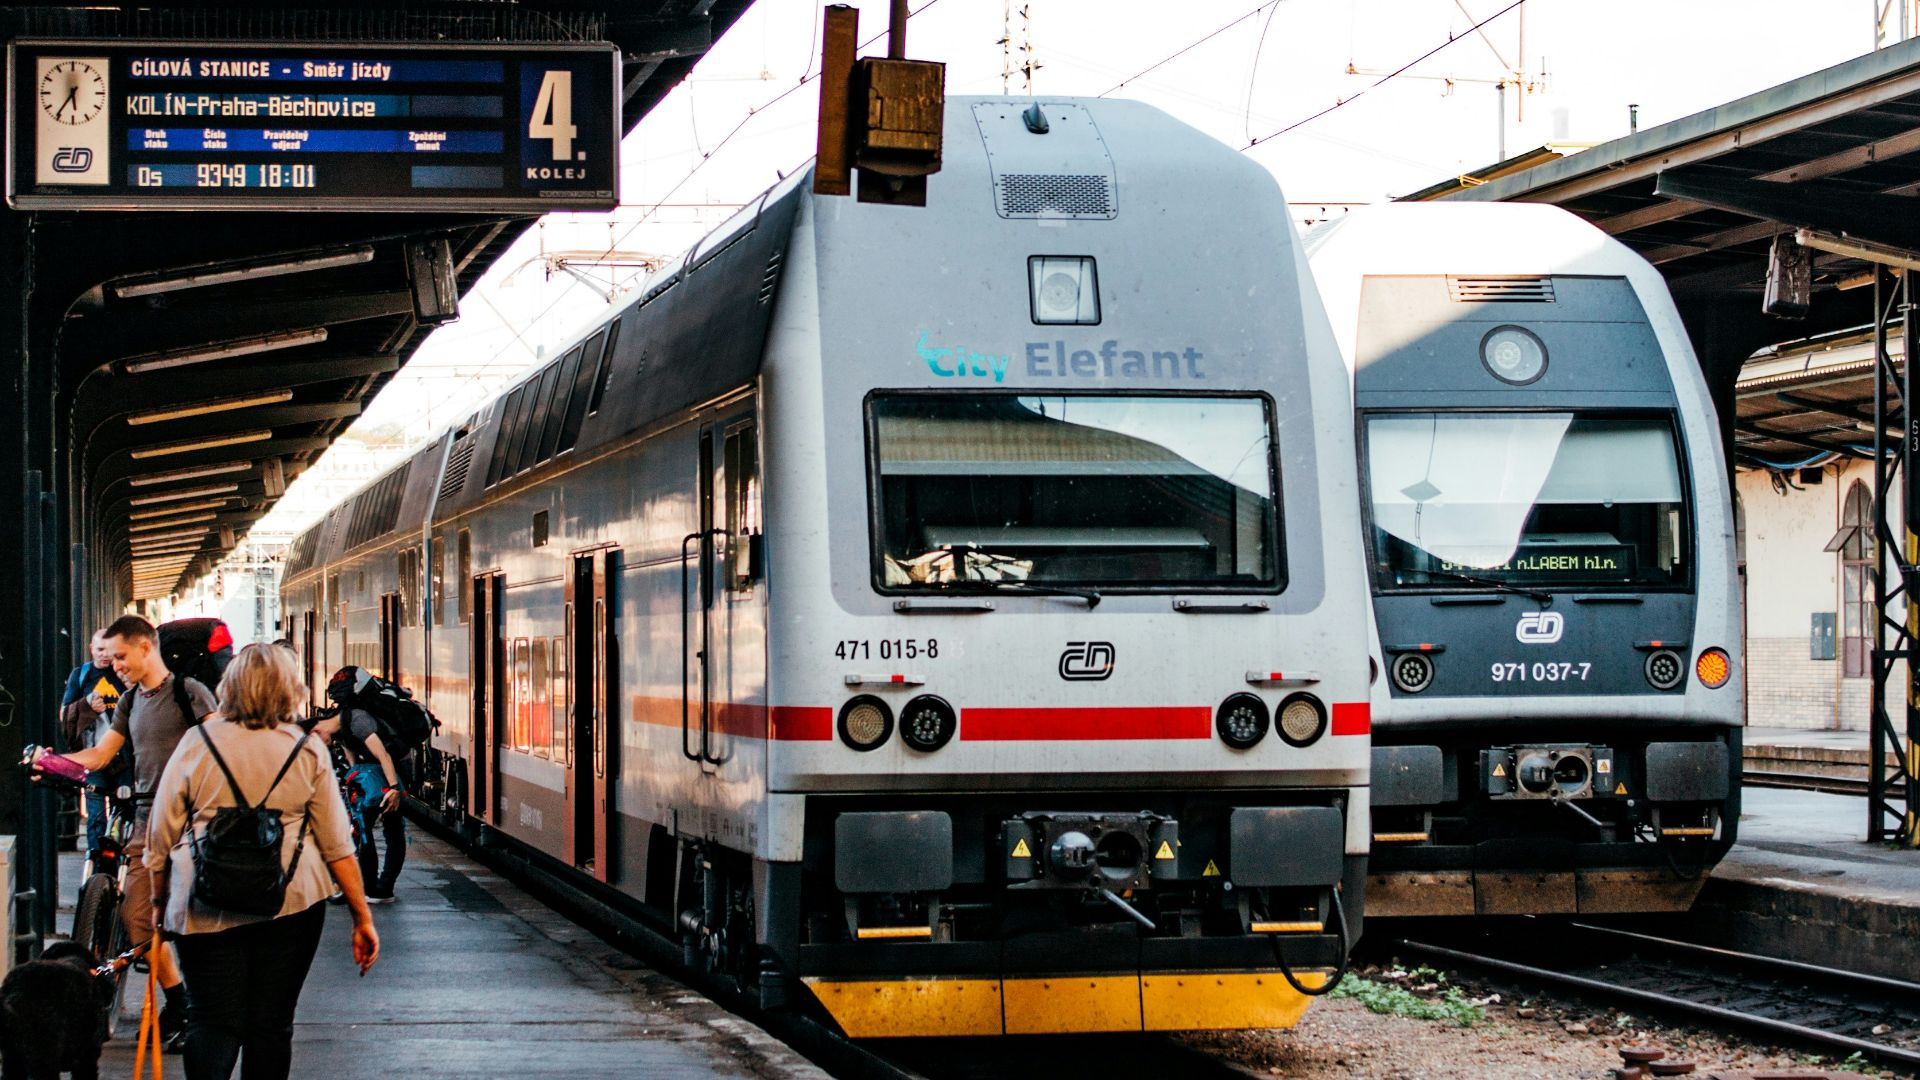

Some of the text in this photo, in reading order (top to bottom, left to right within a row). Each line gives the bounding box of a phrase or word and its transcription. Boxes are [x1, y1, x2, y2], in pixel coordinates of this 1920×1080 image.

[131, 58, 192, 77] CÍLOVÁ
[200, 61, 270, 77] STANICE
[303, 62, 345, 78] Směr
[351, 62, 391, 81] jízdy
[126, 93, 376, 117] KOLÍN-Praha-Běchovice
[529, 70, 586, 161] 4.
[144, 129, 167, 139] Druh
[203, 128, 227, 139] Číslo
[263, 130, 309, 141] Pravidelný
[409, 131, 447, 142] Zpoždění
[144, 139, 168, 149] vlaku
[203, 139, 228, 149] vlaku
[272, 140, 301, 151] odjezd
[415, 141, 440, 151] minut
[197, 164, 247, 187] 9349
[259, 164, 315, 188] 18:01
[526, 167, 586, 179] KOLEJ
[917, 329, 1206, 383] City Elefant
[1517, 555, 1578, 570] n.LABEM
[835, 638, 939, 660] 471 015-8
[1491, 662, 1592, 681] 971 037-7
